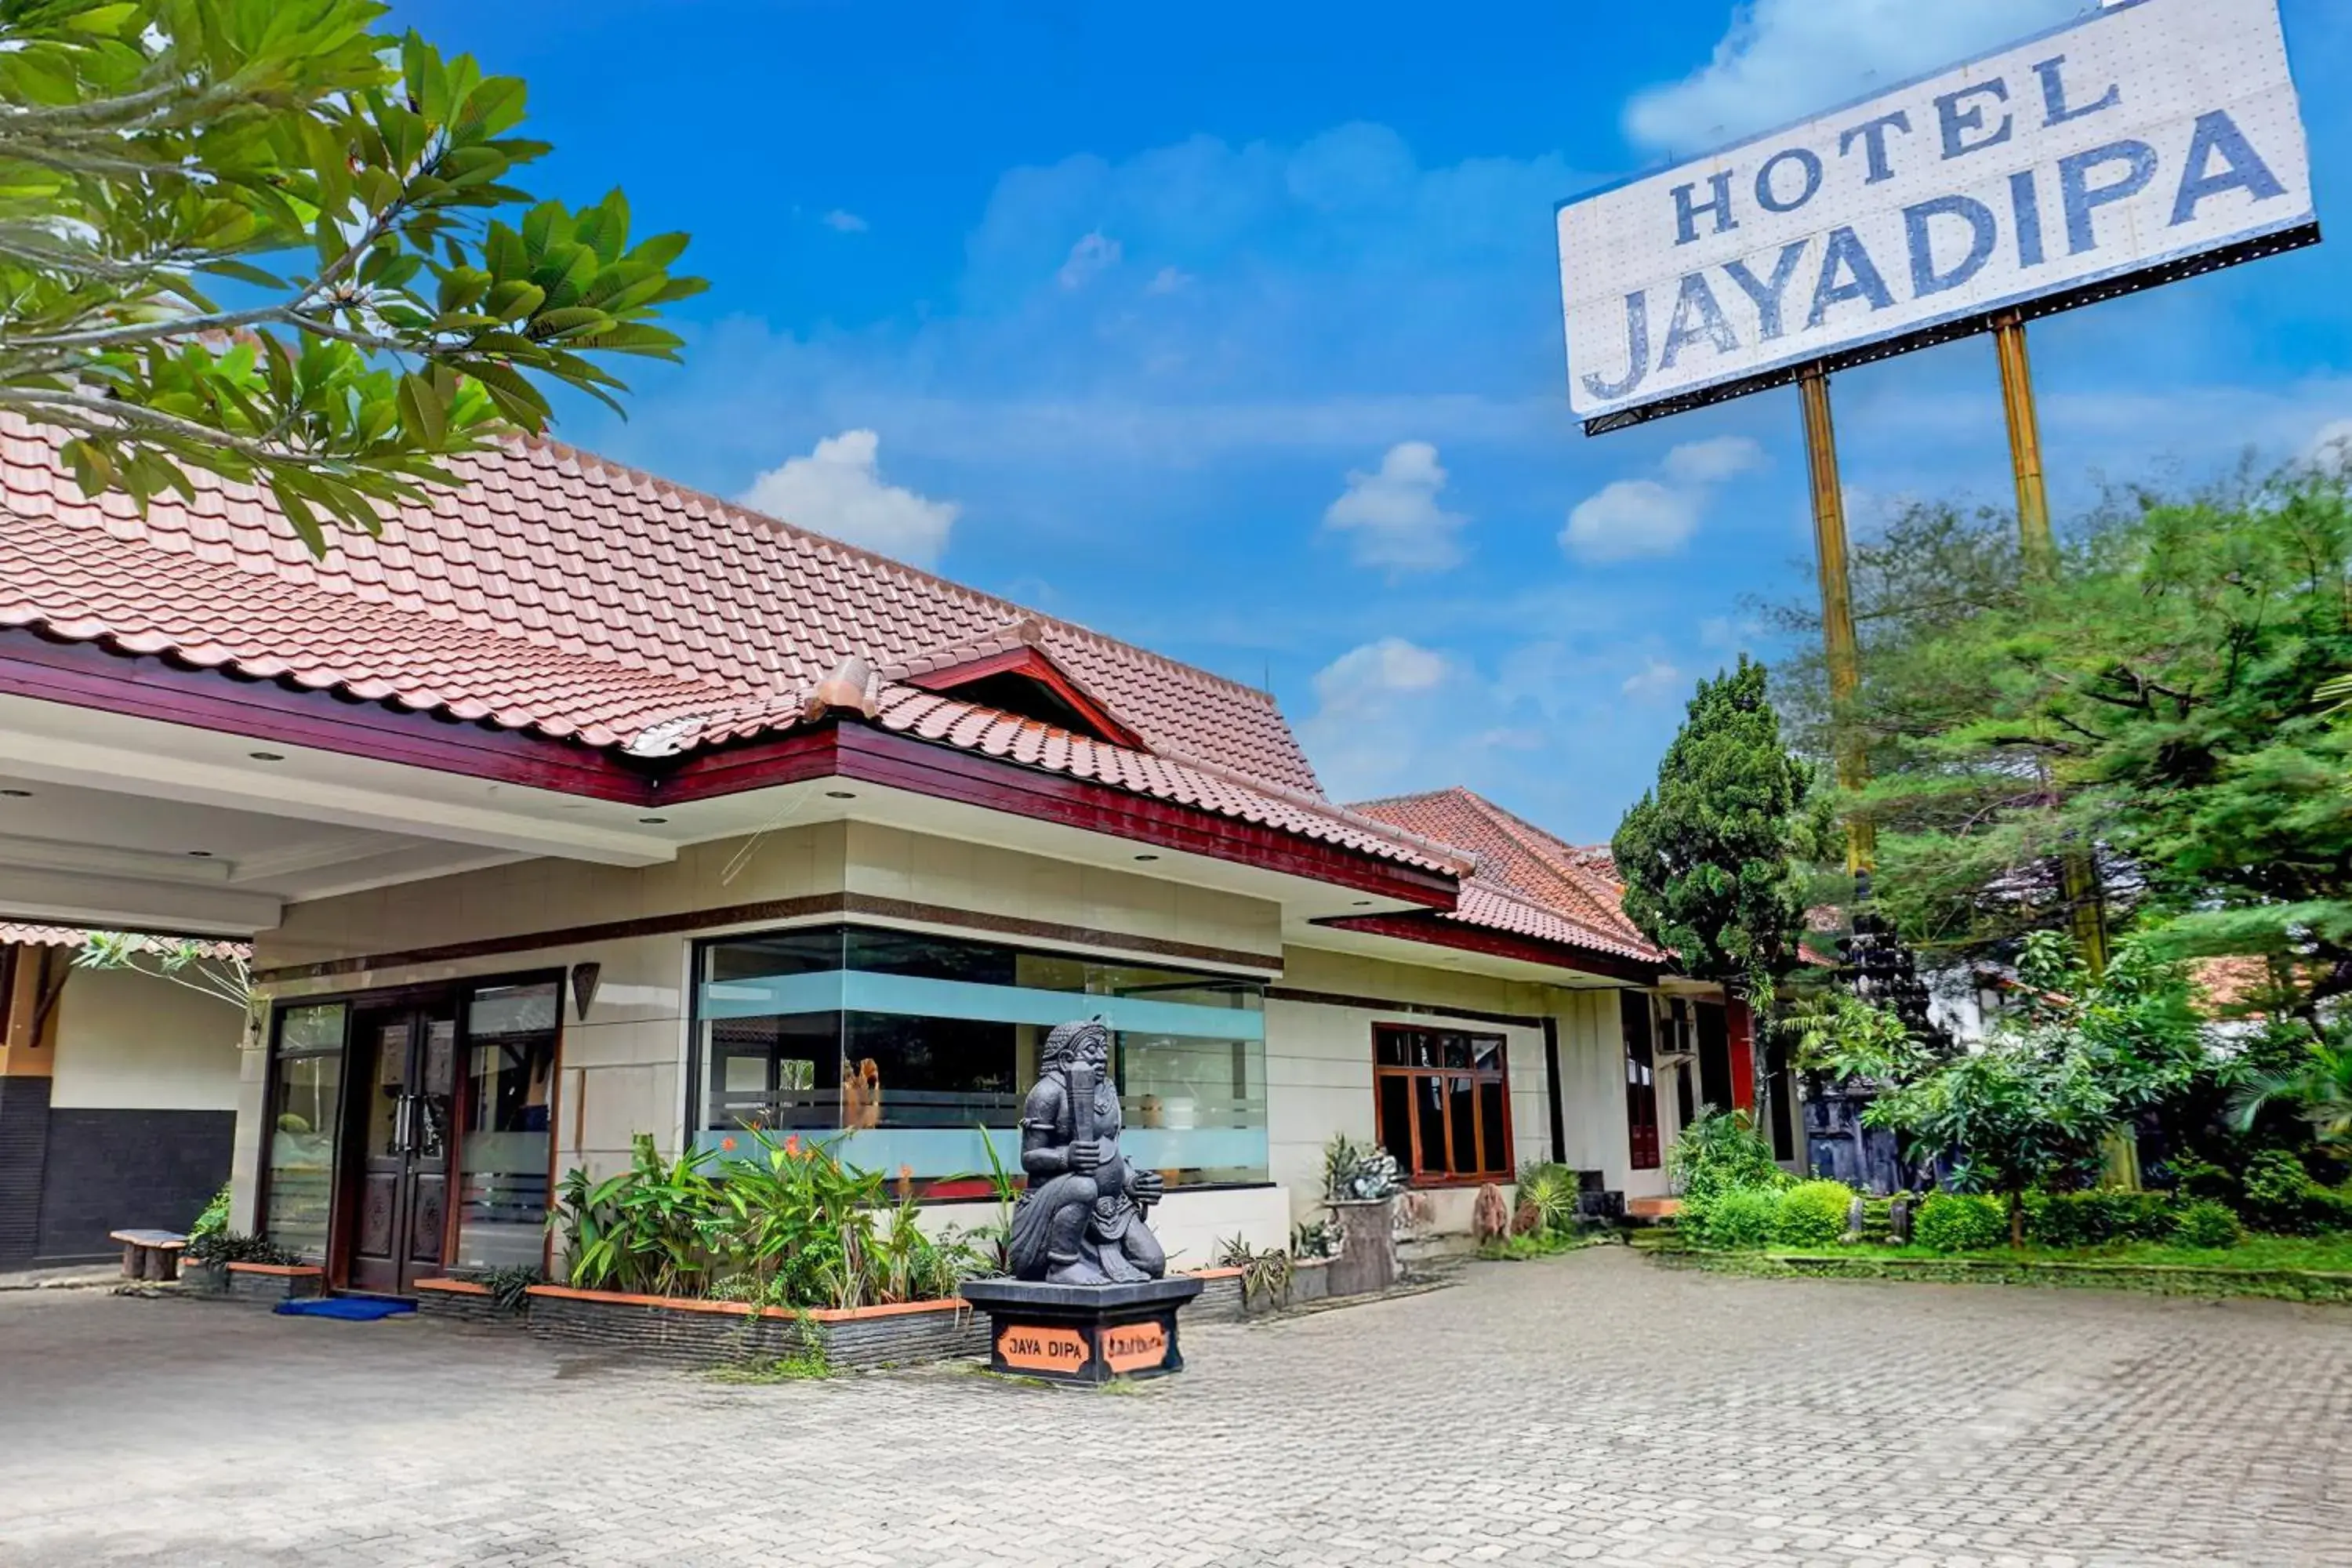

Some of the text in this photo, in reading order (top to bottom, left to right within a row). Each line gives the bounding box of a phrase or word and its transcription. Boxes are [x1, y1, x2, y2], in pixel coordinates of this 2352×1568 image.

[1670, 54, 2121, 246] HOTEL
[1581, 108, 2289, 401] JAYADIPA
[1009, 1338, 1082, 1359] JAYA DIPA
